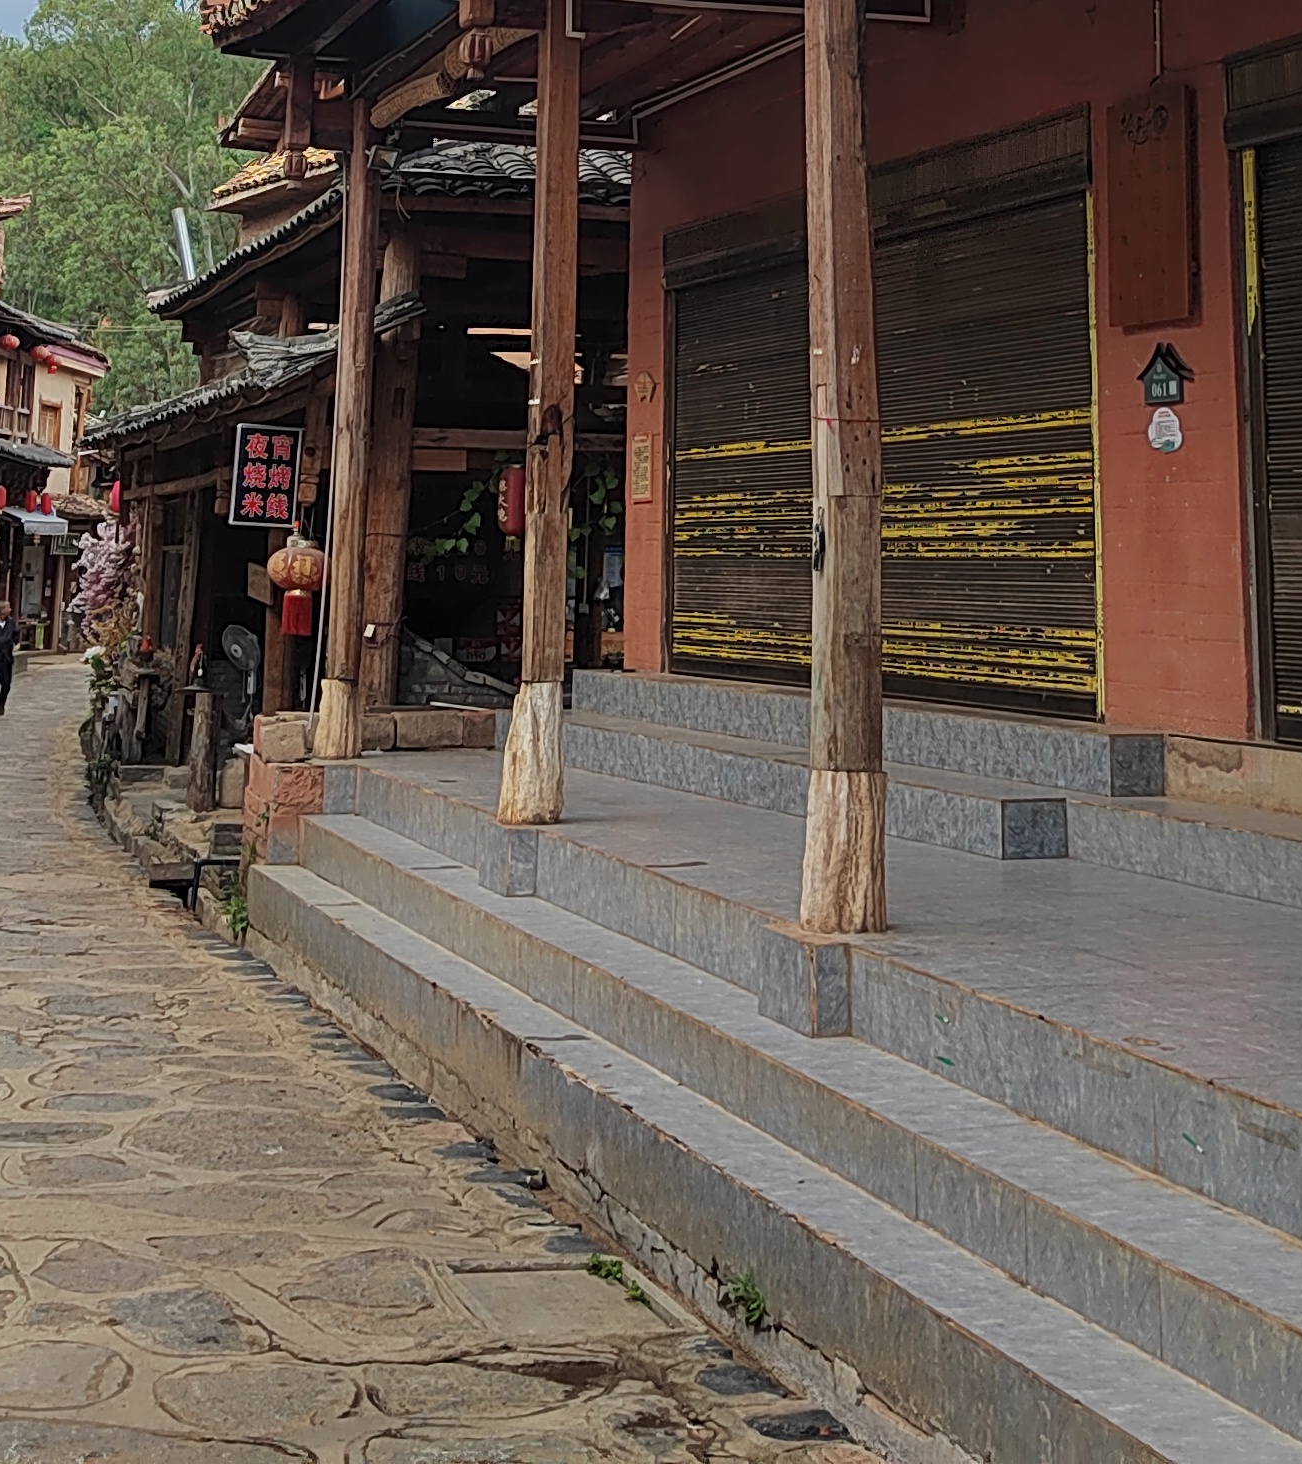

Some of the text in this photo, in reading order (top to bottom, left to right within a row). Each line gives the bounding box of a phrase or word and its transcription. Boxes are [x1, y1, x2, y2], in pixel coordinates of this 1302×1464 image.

[1151, 381, 1167, 398] 061
[245, 433, 294, 461] 夜宵
[242, 462, 292, 490] 烧烤
[240, 492, 289, 520] 米线
